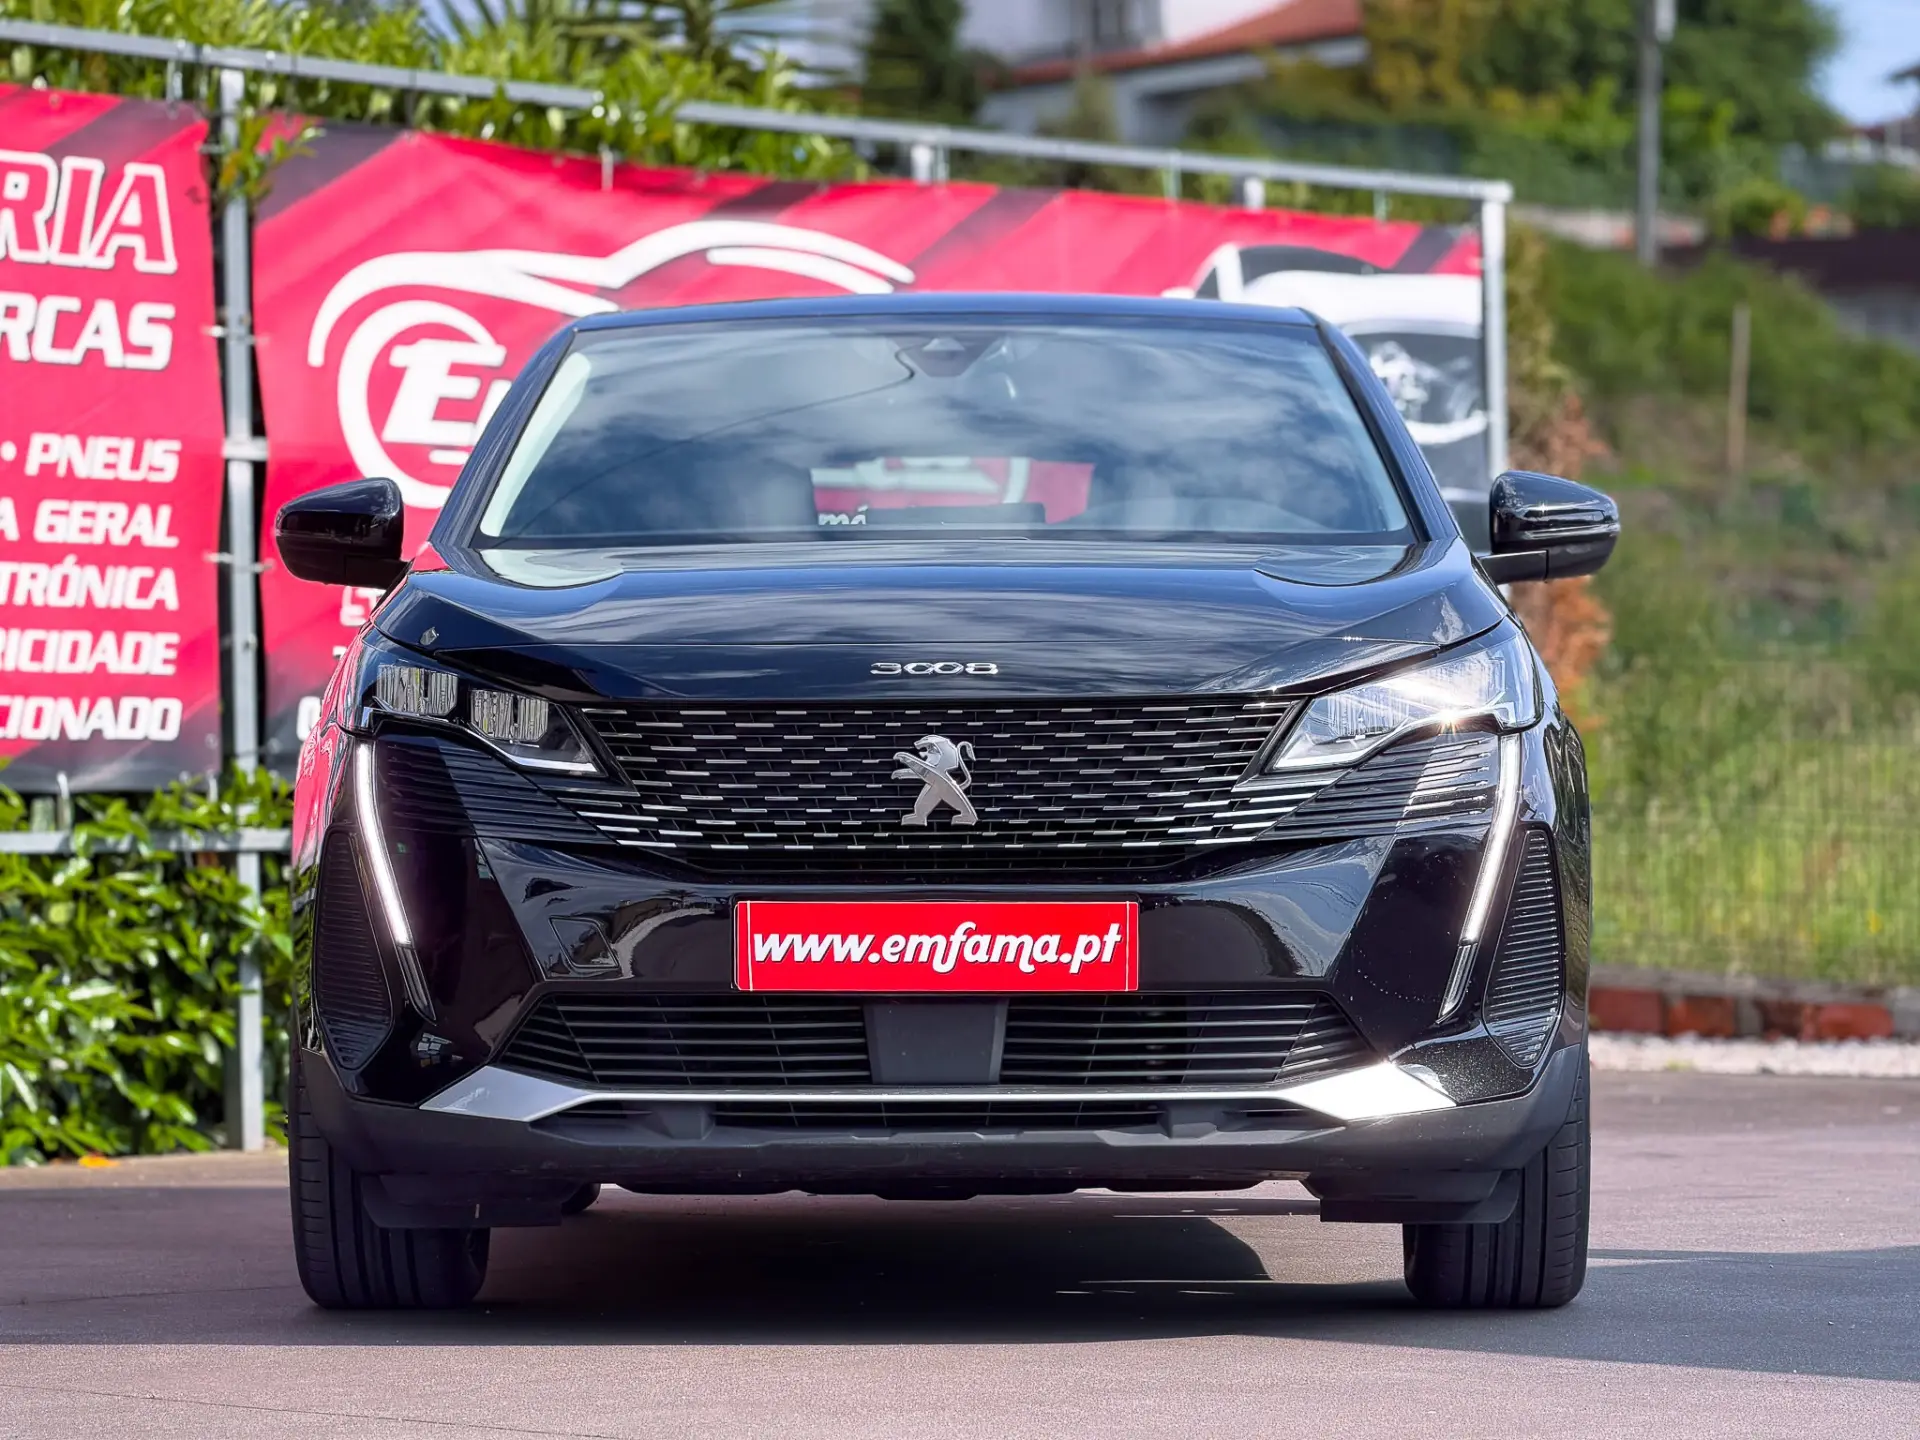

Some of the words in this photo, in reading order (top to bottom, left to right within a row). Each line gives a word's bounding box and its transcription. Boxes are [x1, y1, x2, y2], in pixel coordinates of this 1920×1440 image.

[24, 432, 182, 483] PNEUS
[33, 498, 179, 547] GERAL
[0, 554, 179, 611] TRÓNICA
[0, 627, 180, 676] ICIDADE
[870, 661, 999, 675] 3008
[753, 921, 1122, 974] www.emfama.pt
